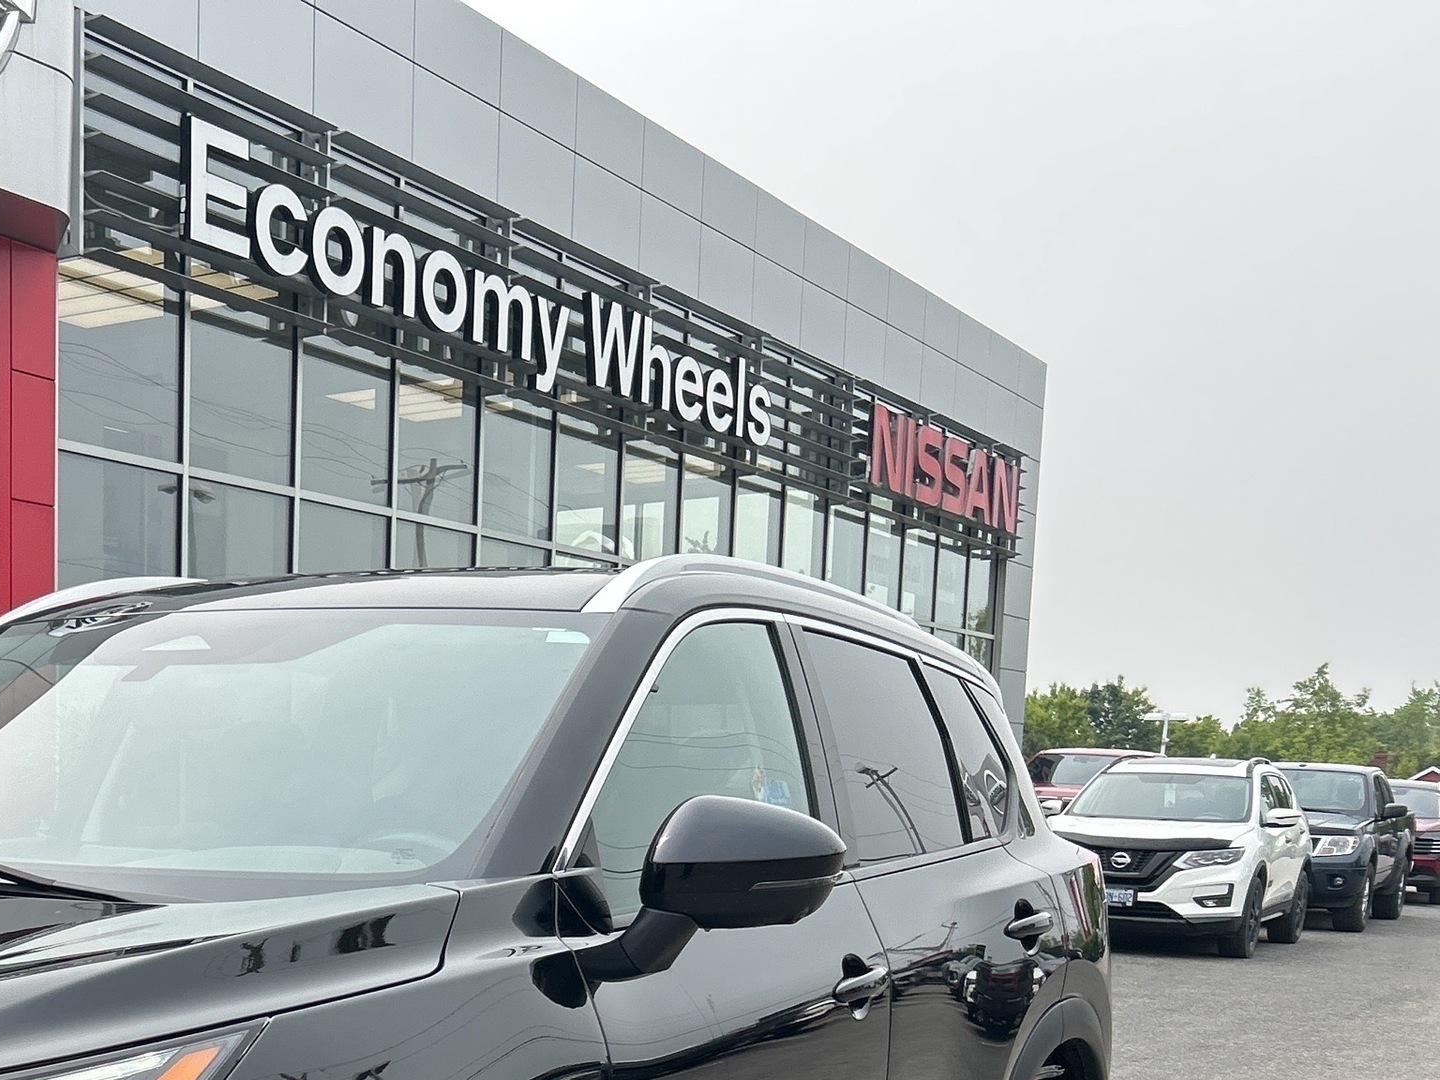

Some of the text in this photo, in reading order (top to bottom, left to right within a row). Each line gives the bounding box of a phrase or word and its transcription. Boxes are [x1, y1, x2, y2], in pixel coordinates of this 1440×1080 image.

[182, 114, 774, 447] Economy Wheels
[869, 402, 1020, 535] NISSAN
